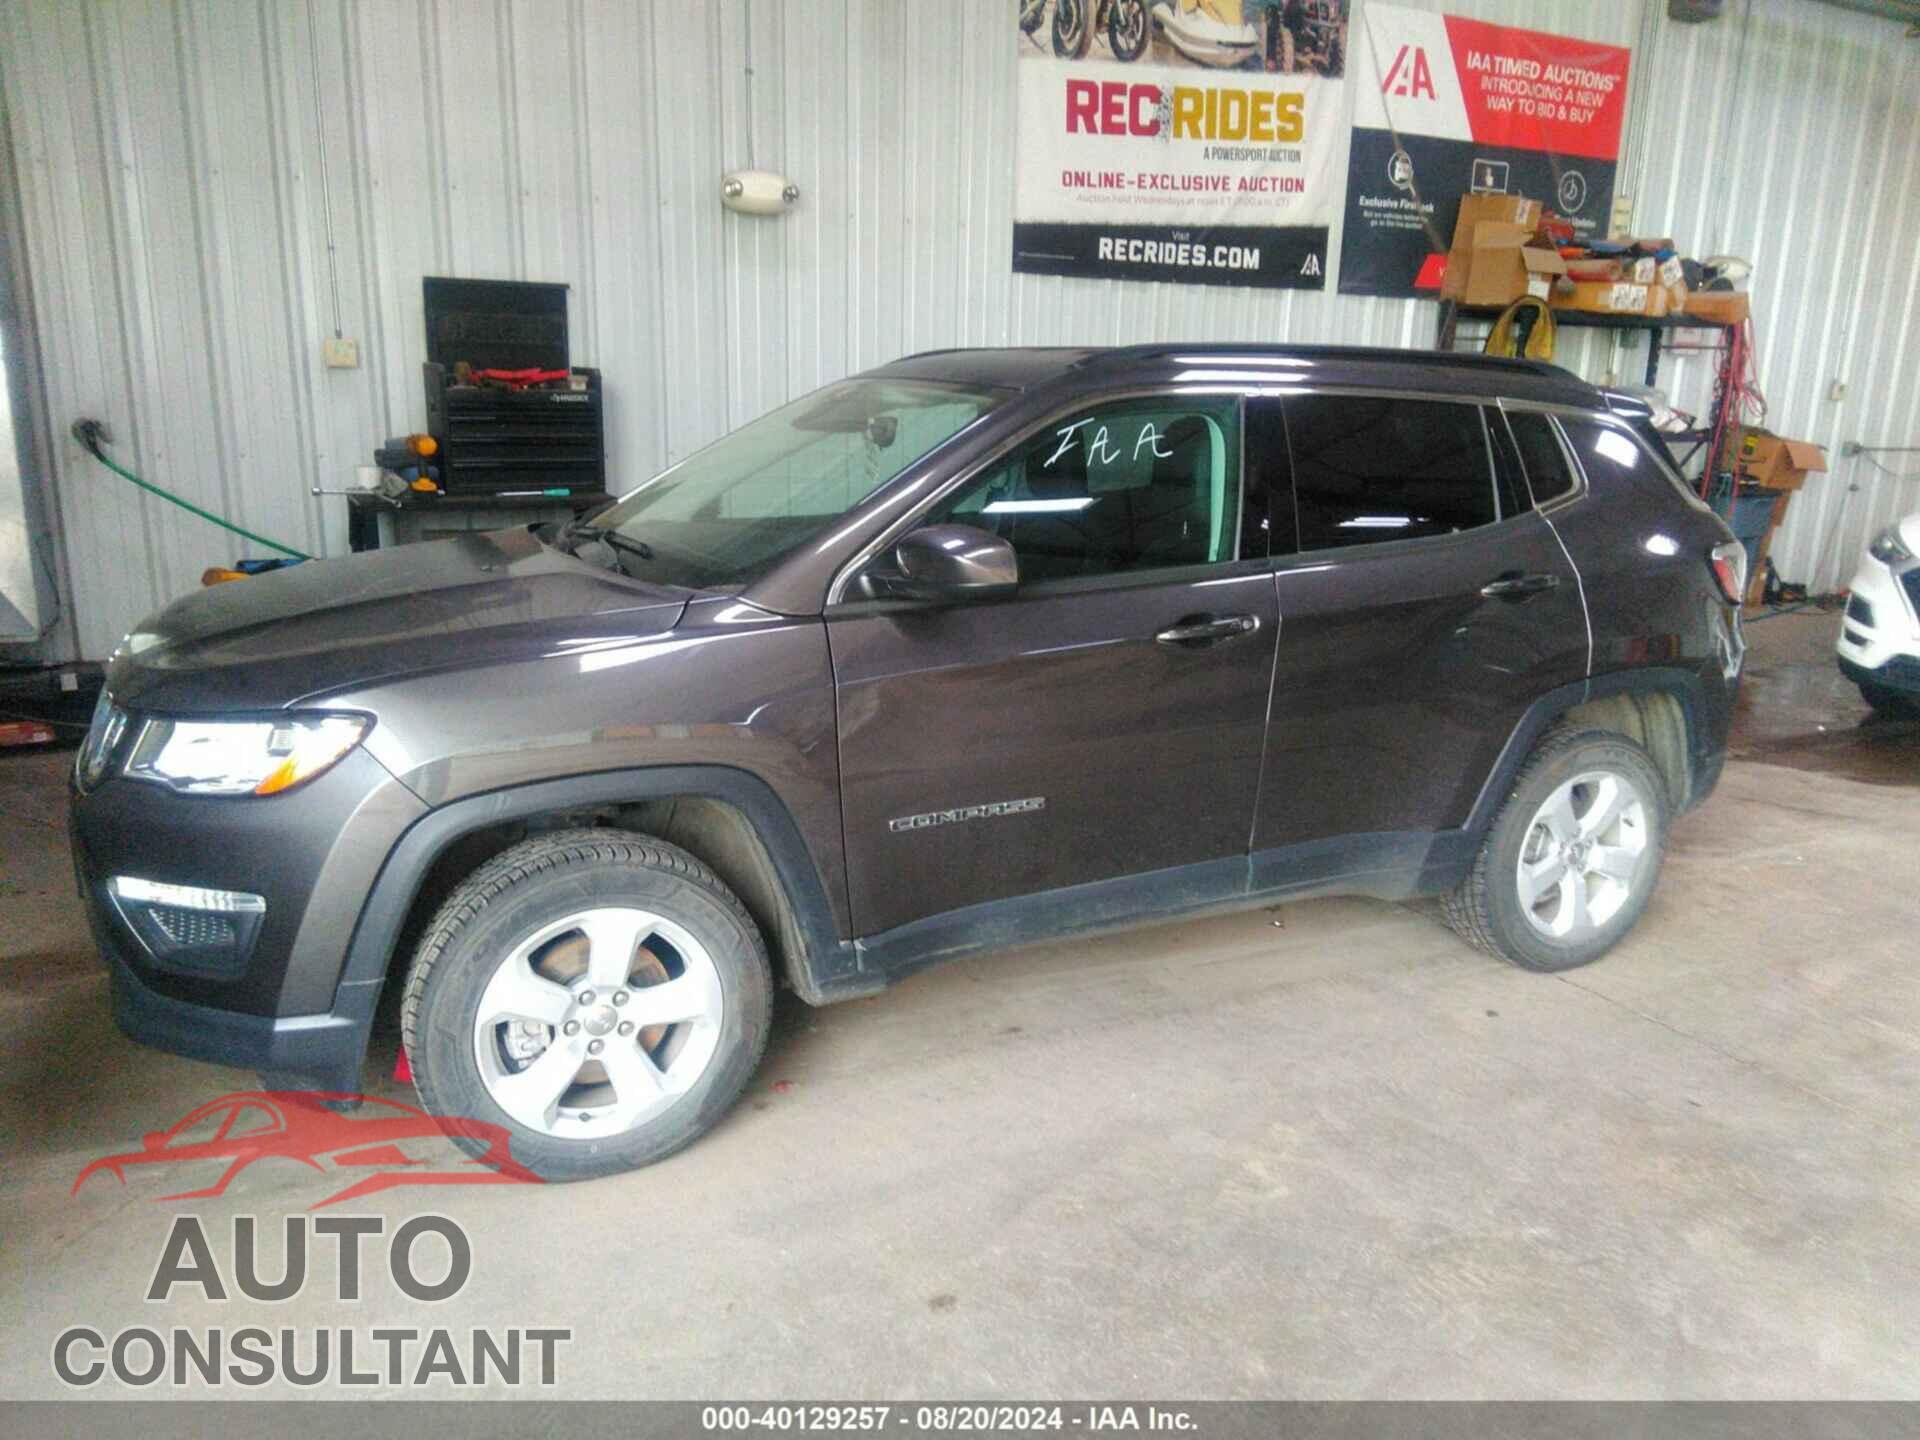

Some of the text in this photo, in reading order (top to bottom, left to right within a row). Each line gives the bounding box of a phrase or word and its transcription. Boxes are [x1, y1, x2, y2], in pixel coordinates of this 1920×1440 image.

[1467, 50, 1491, 73] IAA
[1494, 56, 1540, 78] TIMED
[1481, 75, 1605, 107] INTRODUCING A NEW
[1066, 79, 1305, 143] REC RIDES
[1487, 95, 1594, 124] WAY TO BID & BUY
[1203, 146, 1301, 163] A POWERSPORT AUCTION
[1062, 171, 1305, 193] ONLINE-EXCLUSIVE AUCTION
[1099, 237, 1259, 270] RECRIDES.COM
[889, 797, 1045, 832] COMPASS
